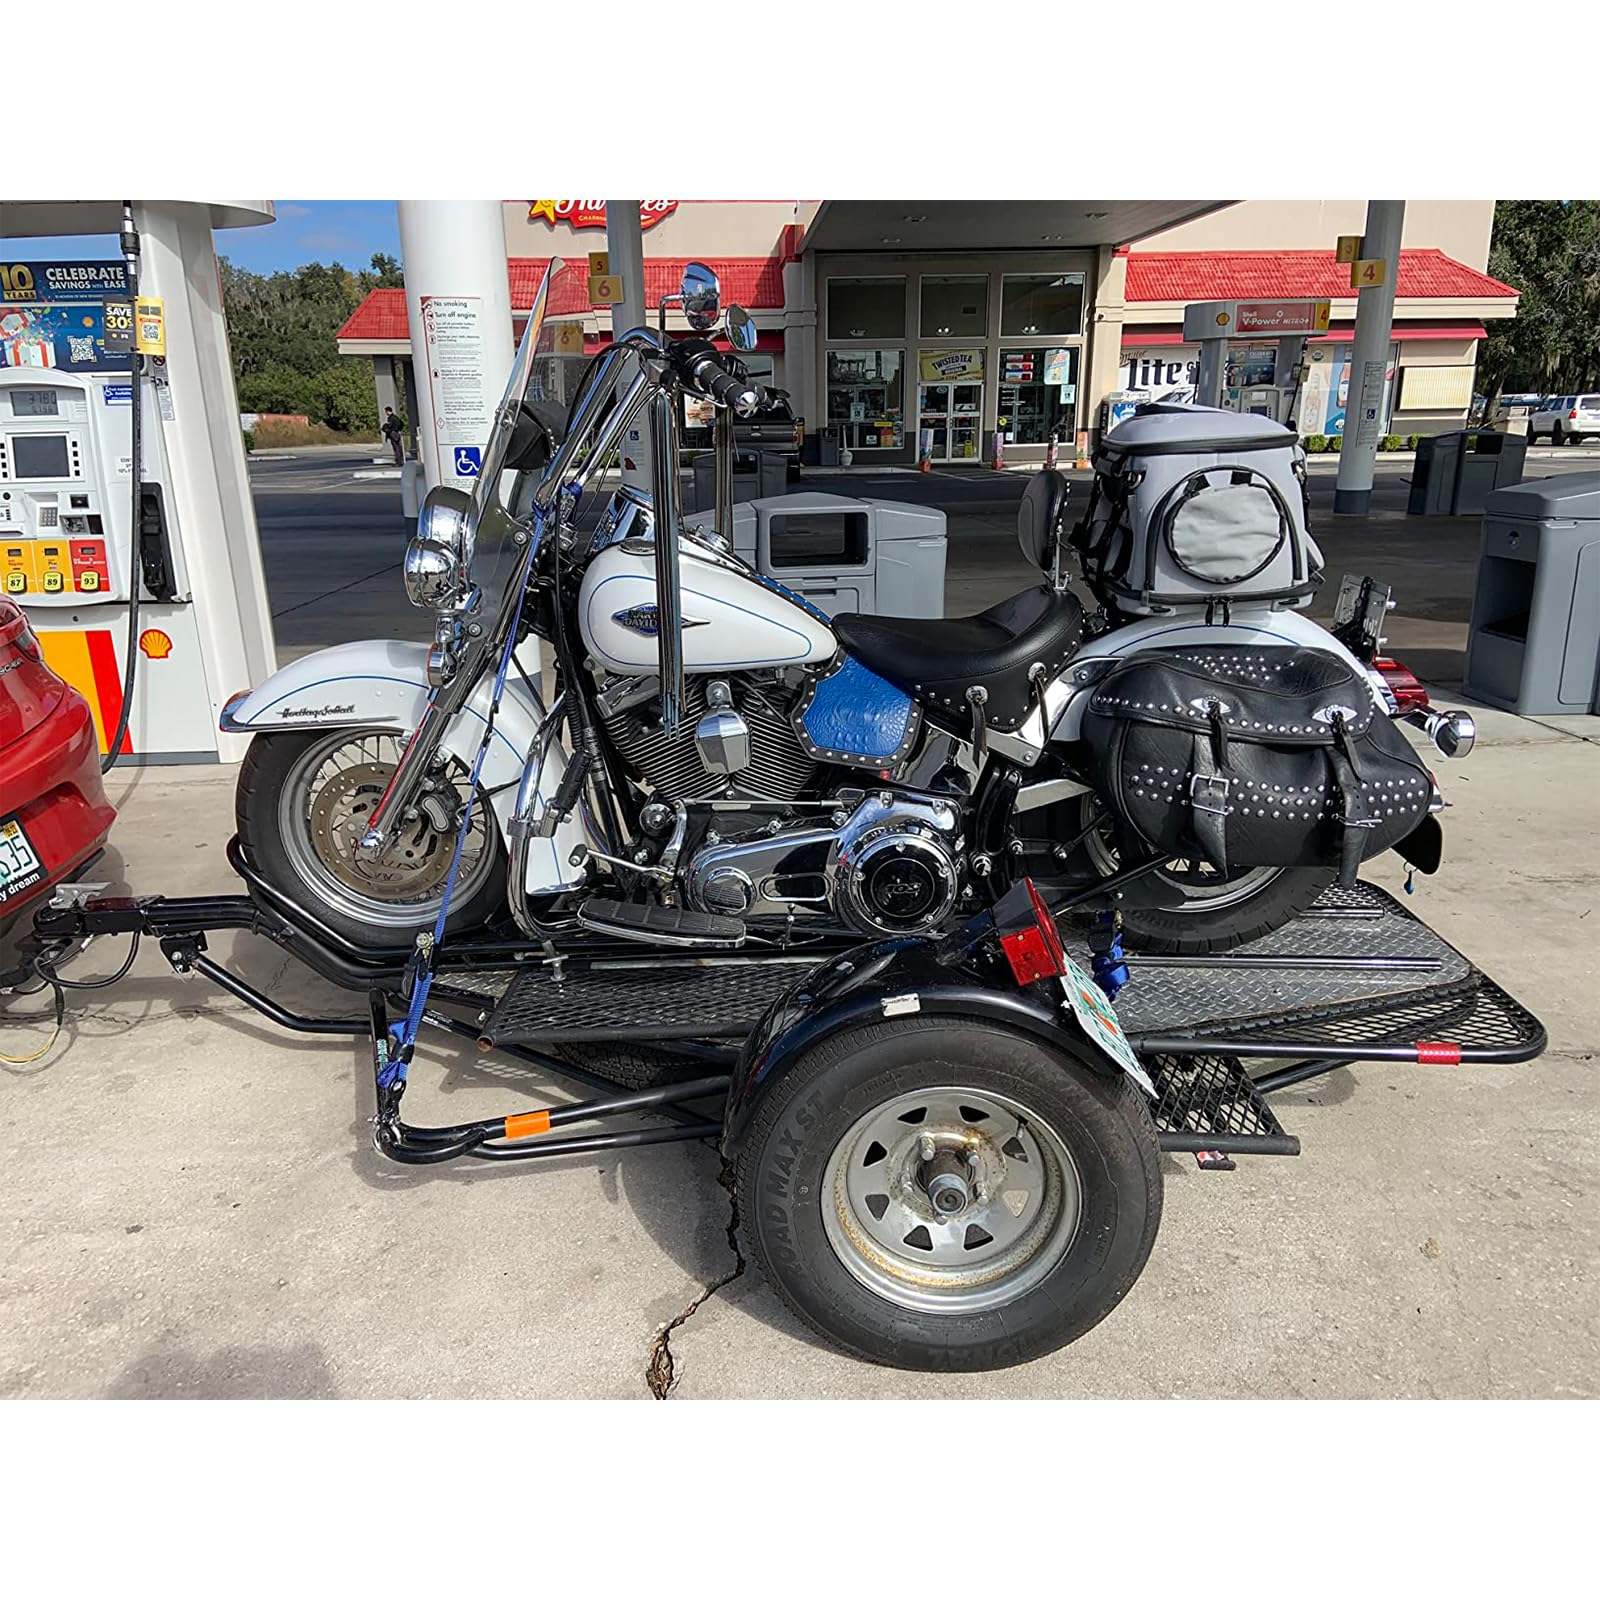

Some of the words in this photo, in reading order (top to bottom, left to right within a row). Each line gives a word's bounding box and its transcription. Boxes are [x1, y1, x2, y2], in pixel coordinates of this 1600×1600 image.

[596, 261, 603, 271] 5
[0, 264, 34, 290] 10
[46, 267, 125, 280] CELEBRATE
[1363, 264, 1375, 280] 4
[49, 281, 91, 290] SAVINGS
[104, 281, 126, 289] EASE
[598, 280, 611, 297] 6
[6, 291, 35, 300] YEARS
[444, 300, 468, 308] smoking
[106, 306, 132, 317] SAVE
[1320, 309, 1327, 322] 4
[1242, 317, 1280, 326] V-Power
[931, 355, 960, 370] TWISTED
[960, 354, 972, 363] TEA
[1126, 358, 1182, 391] Lite
[10, 579, 21, 587] 87
[47, 578, 58, 586] 89
[84, 577, 95, 585] 93
[624, 618, 658, 627] DAVID
[8, 873, 40, 895] dream
[765, 1127, 803, 1198] MAX
[795, 1089, 825, 1132] ST
